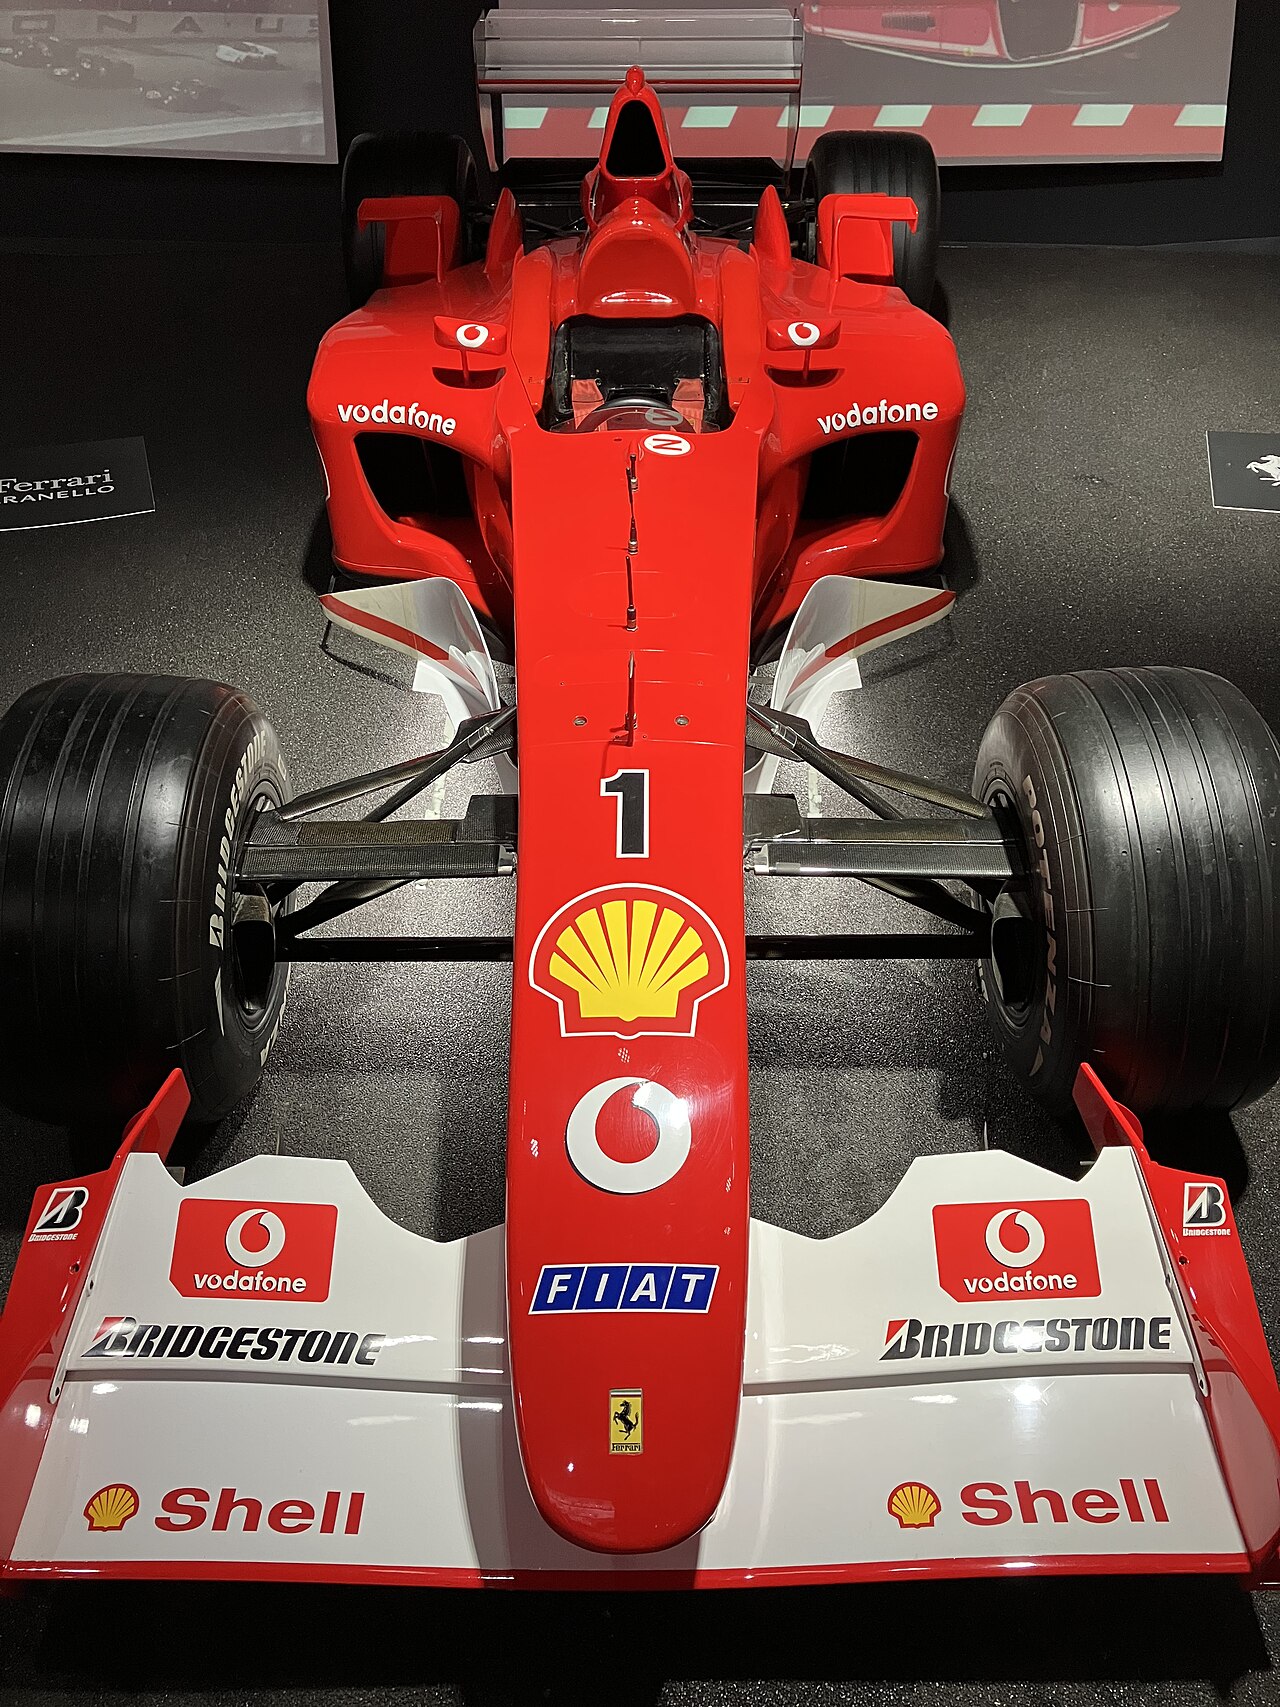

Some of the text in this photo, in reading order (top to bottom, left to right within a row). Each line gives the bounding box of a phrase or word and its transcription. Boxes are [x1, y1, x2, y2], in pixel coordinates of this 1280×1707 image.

[337, 399, 457, 436] vodafone
[816, 399, 938, 434] vodafone
[0, 485, 115, 504] RANELLO
[600, 768, 649, 859] 1
[194, 1270, 307, 1294] vodafone
[546, 1272, 706, 1304] FIAT
[963, 1271, 1078, 1294] vodafone
[80, 1316, 387, 1366] BRIDGESTONE
[879, 1316, 1172, 1361] BRIDGESTONE
[154, 1486, 366, 1536] Shell
[960, 1477, 1171, 1527] Shell
